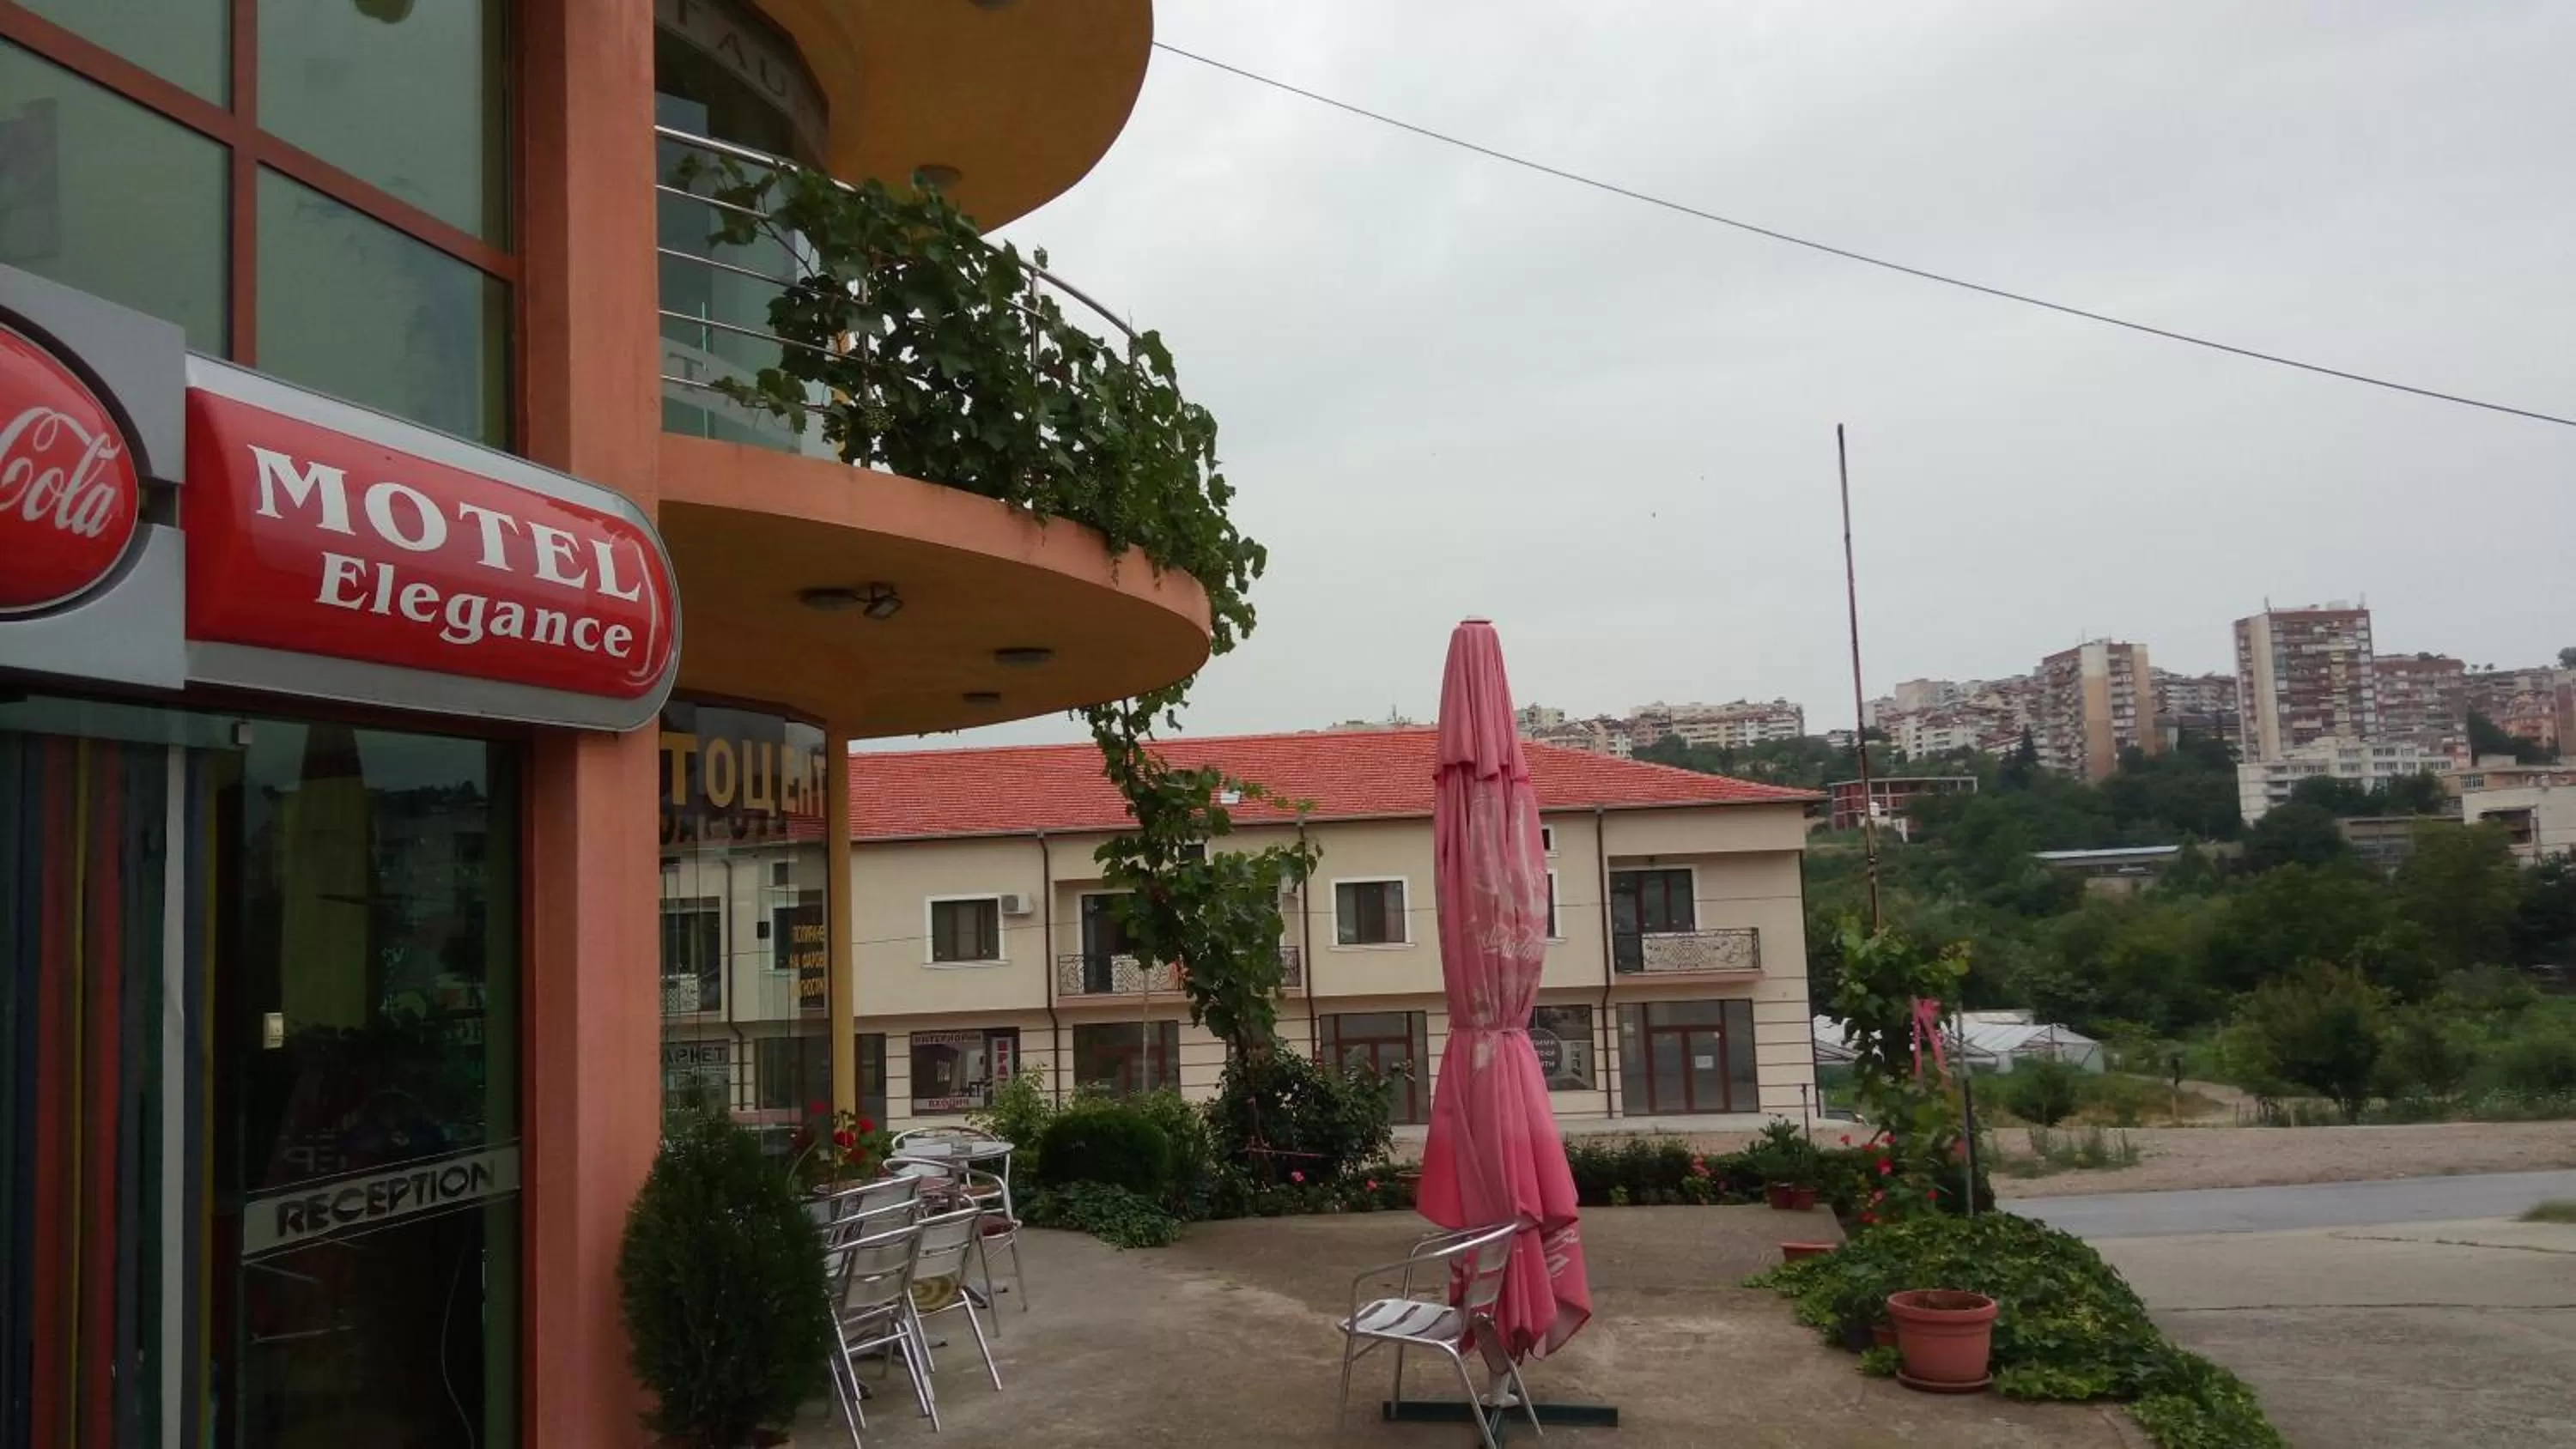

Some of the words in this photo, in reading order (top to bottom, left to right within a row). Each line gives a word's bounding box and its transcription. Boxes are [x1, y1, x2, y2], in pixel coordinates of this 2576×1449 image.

[0, 406, 121, 538] Cola
[246, 443, 642, 603] MOTEL
[316, 551, 634, 659] Elegance
[276, 1160, 495, 1237] RECEPTION
